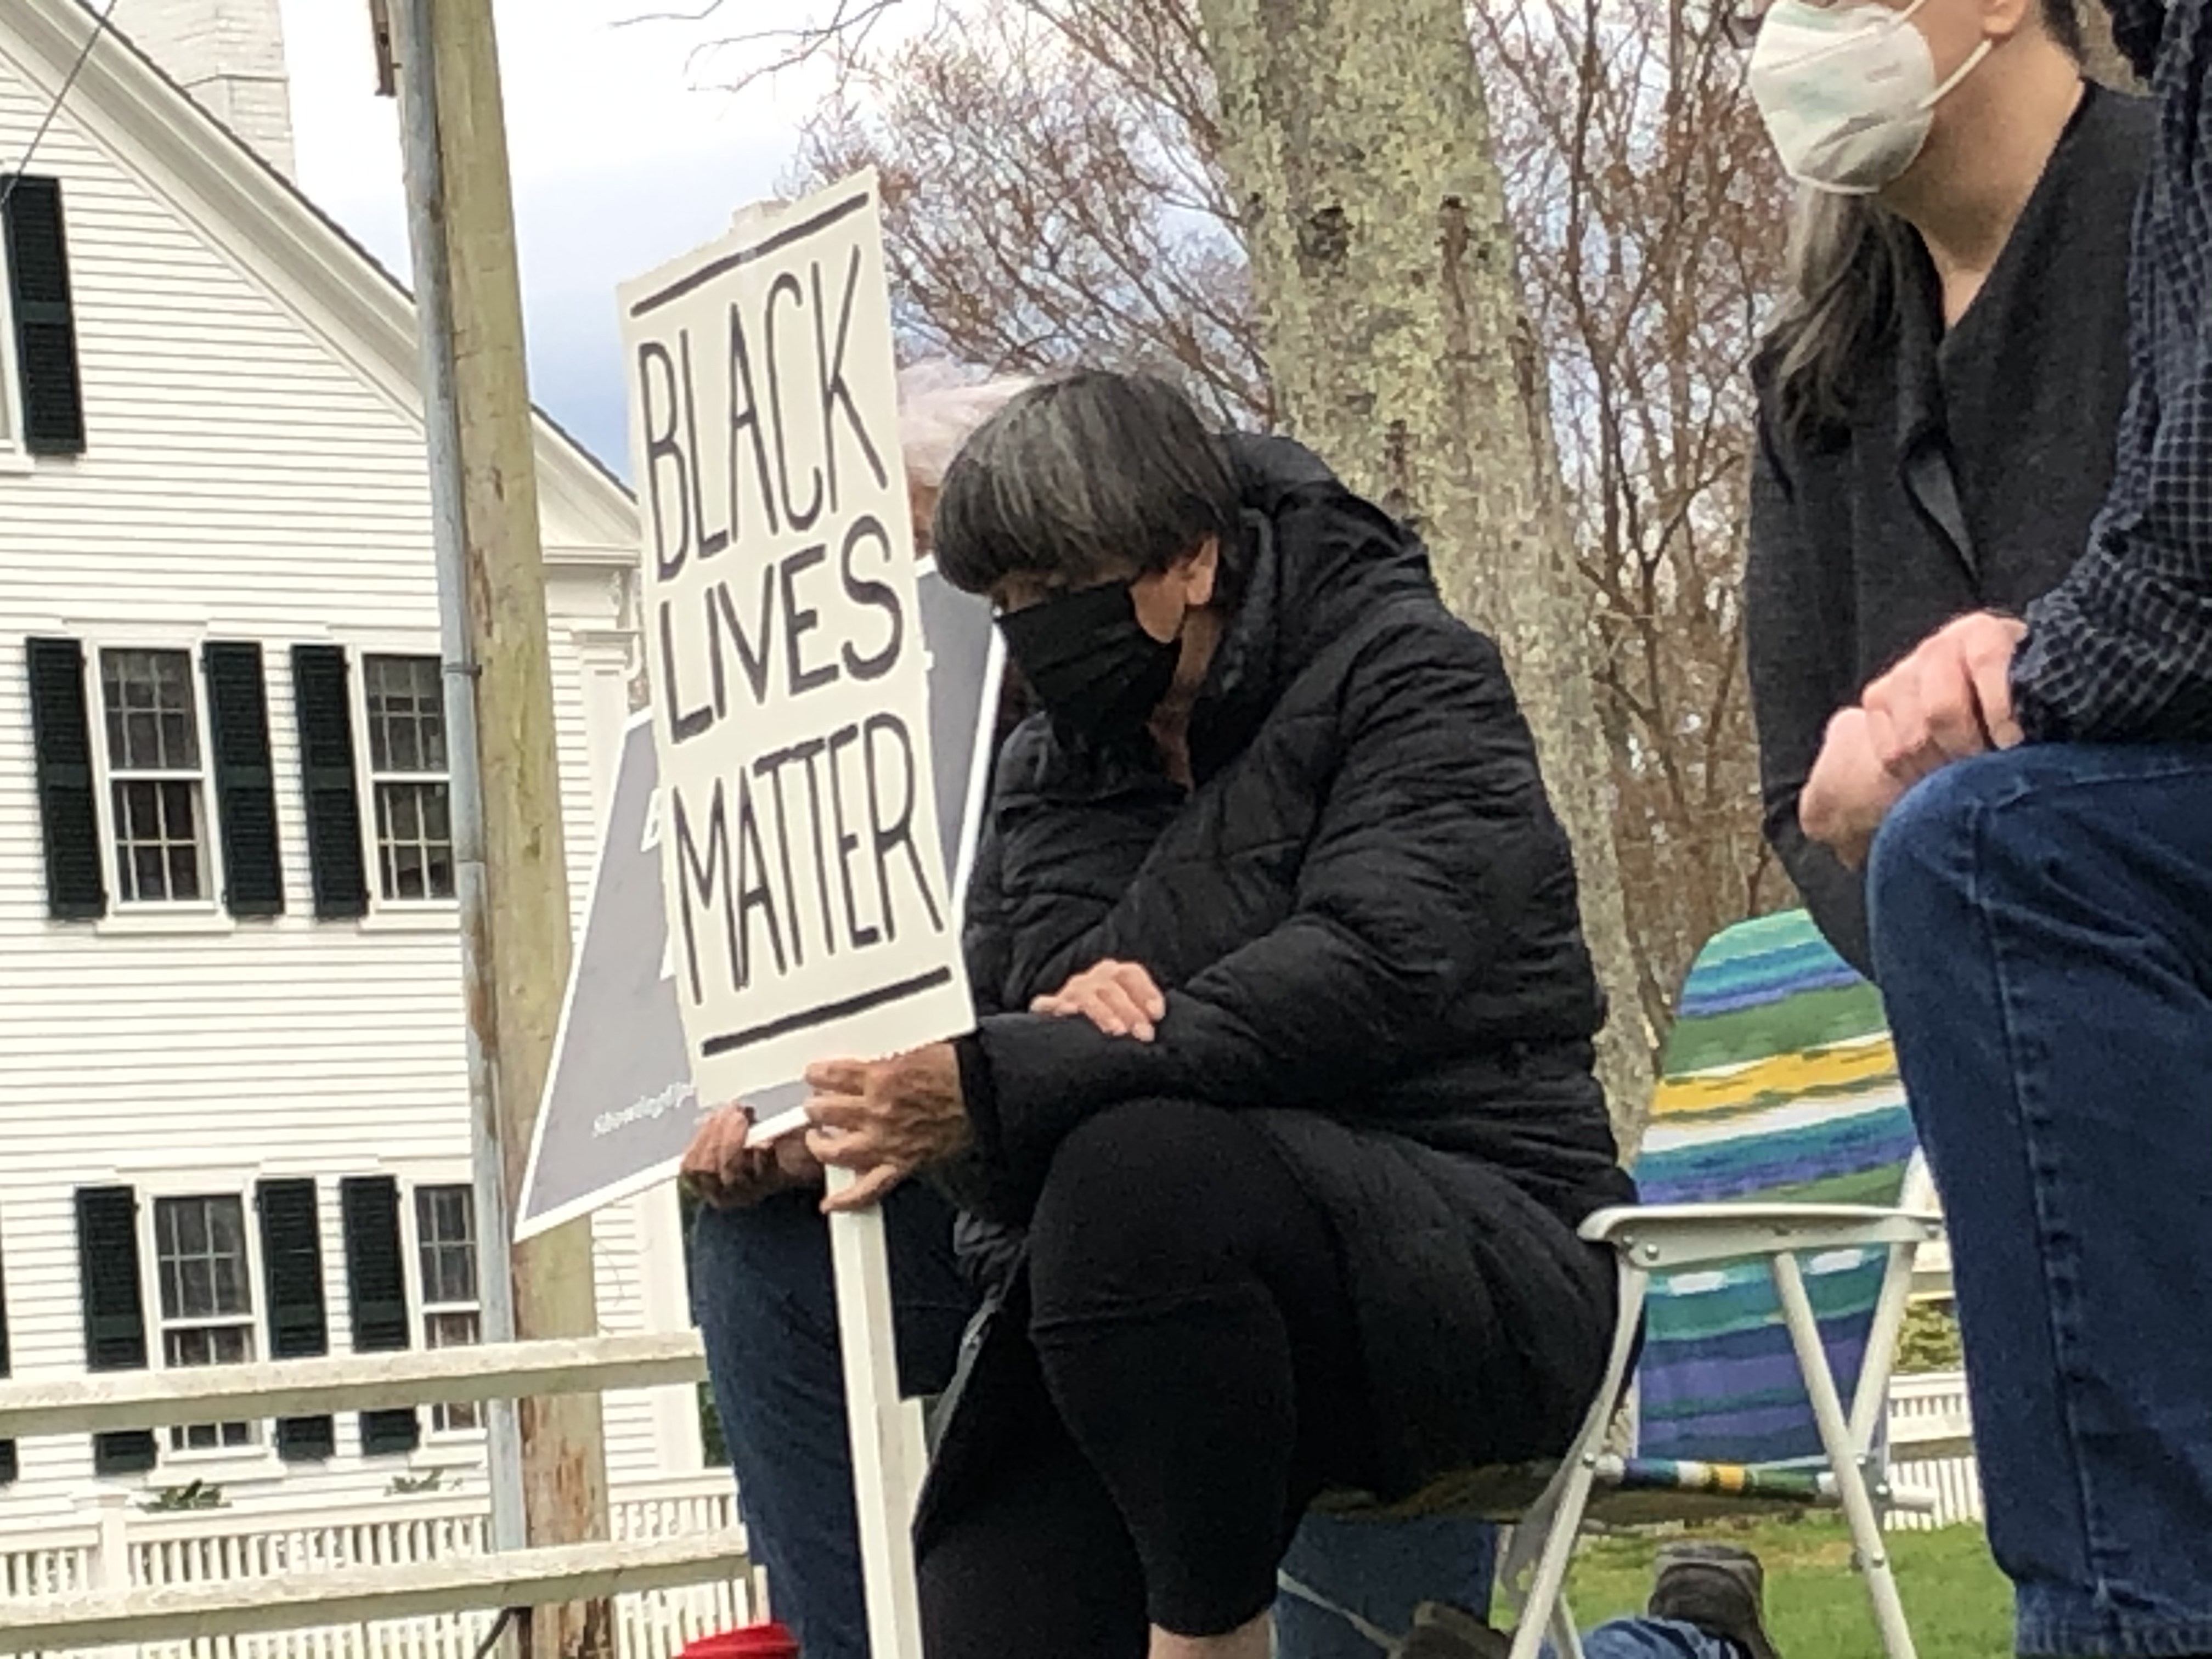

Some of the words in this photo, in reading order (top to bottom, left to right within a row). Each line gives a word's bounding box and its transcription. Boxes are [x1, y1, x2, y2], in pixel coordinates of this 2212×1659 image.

[638, 245, 888, 583] BLACK
[659, 514, 904, 744] LIVES
[673, 712, 944, 1005] MATTER
